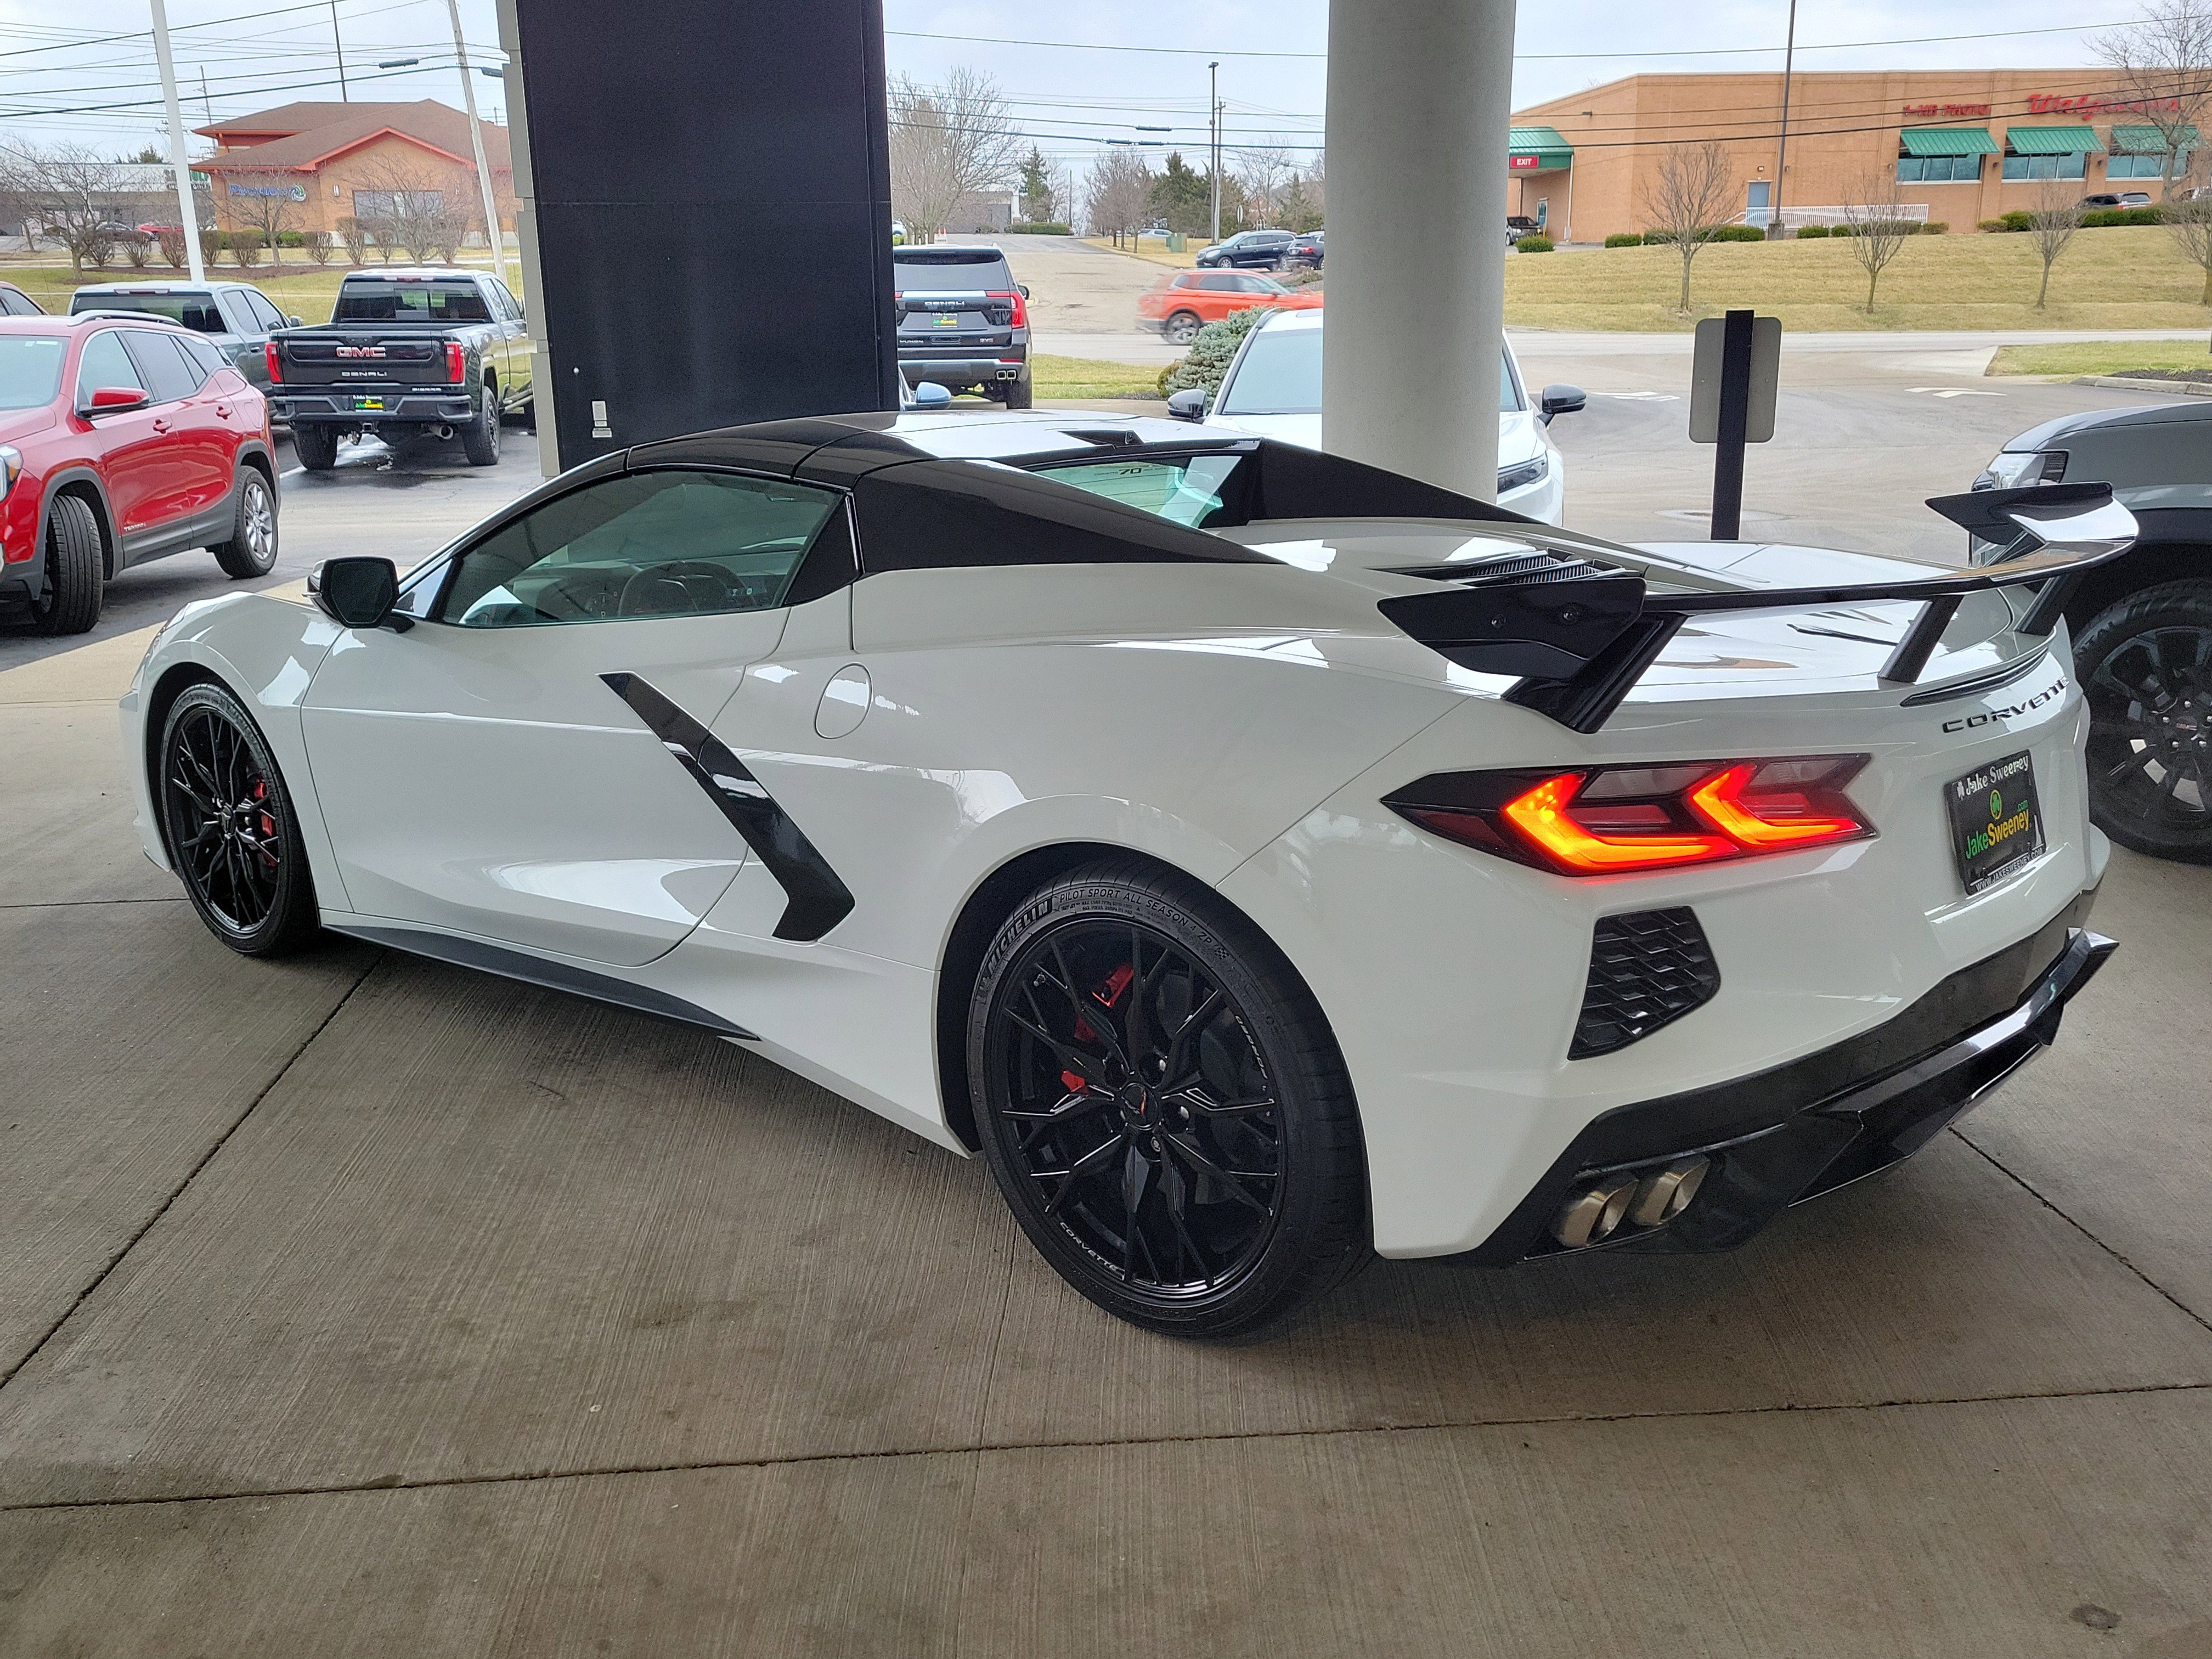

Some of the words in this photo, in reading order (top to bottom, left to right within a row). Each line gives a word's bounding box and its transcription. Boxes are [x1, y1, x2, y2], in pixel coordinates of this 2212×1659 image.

[1942, 103, 1990, 116] PHOTO
[336, 346, 386, 358] GMC
[1942, 676, 2069, 733] CORVETTE
[1966, 773, 1988, 795] Jake
[1966, 809, 2030, 859] JakeSweeney
[1976, 848, 2043, 891] WWW.JAKESWEENEY.COM
[988, 900, 1048, 975] MICHELIN
[1060, 889, 1085, 903] PILOT
[1088, 888, 1121, 899] SPORT
[1124, 893, 1141, 904] ALL
[1146, 900, 1188, 927] SEASON
[1197, 932, 1212, 943] ZP
[1060, 1222, 1117, 1272] CORVETTE
